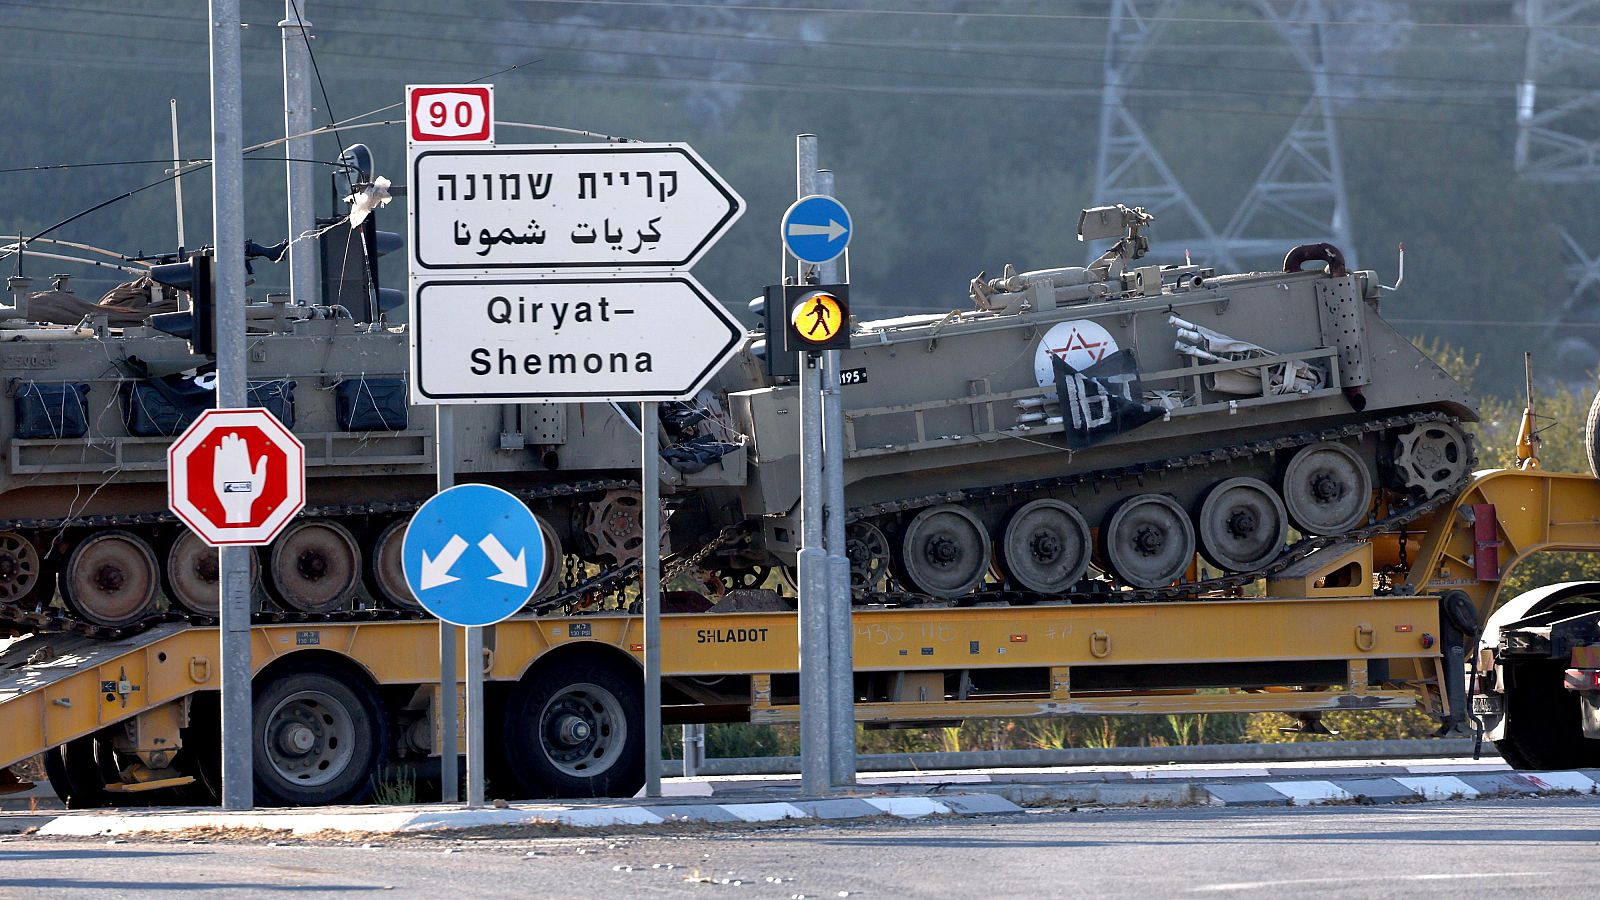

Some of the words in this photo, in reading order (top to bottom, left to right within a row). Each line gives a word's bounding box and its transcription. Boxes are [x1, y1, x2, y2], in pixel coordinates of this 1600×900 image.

[429, 101, 473, 128] 90
[437, 173, 553, 201] שמונה
[578, 171, 678, 203] קריית
[454, 217, 547, 256] شمونا
[487, 296, 635, 330] Qiryat-
[470, 347, 653, 376] Shemona
[839, 370, 860, 384] 195
[697, 628, 769, 644] SHLADOT
